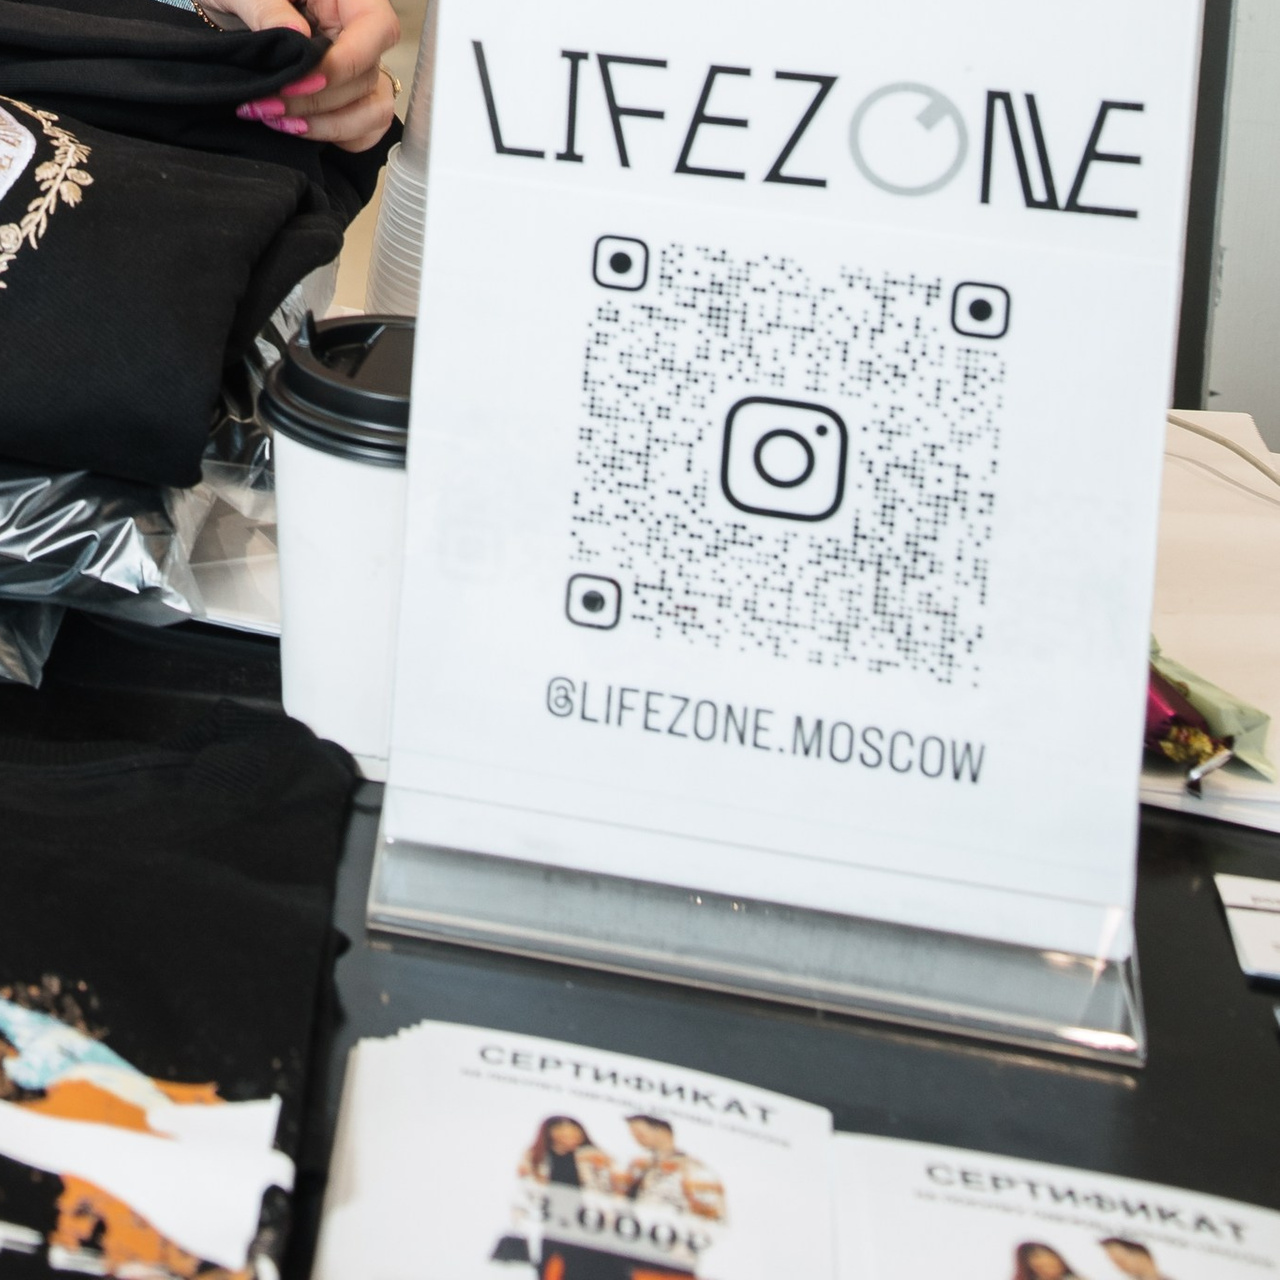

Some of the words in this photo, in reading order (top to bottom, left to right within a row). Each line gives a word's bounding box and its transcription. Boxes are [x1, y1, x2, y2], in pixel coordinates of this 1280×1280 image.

[472, 39, 1145, 220] LIFEZONE
[546, 676, 985, 785] @LIFEZONE.MOSCOW
[479, 1045, 776, 1124] СЕРТИФИКАТ
[925, 1162, 1249, 1242] СЕРТИФИКАТ
